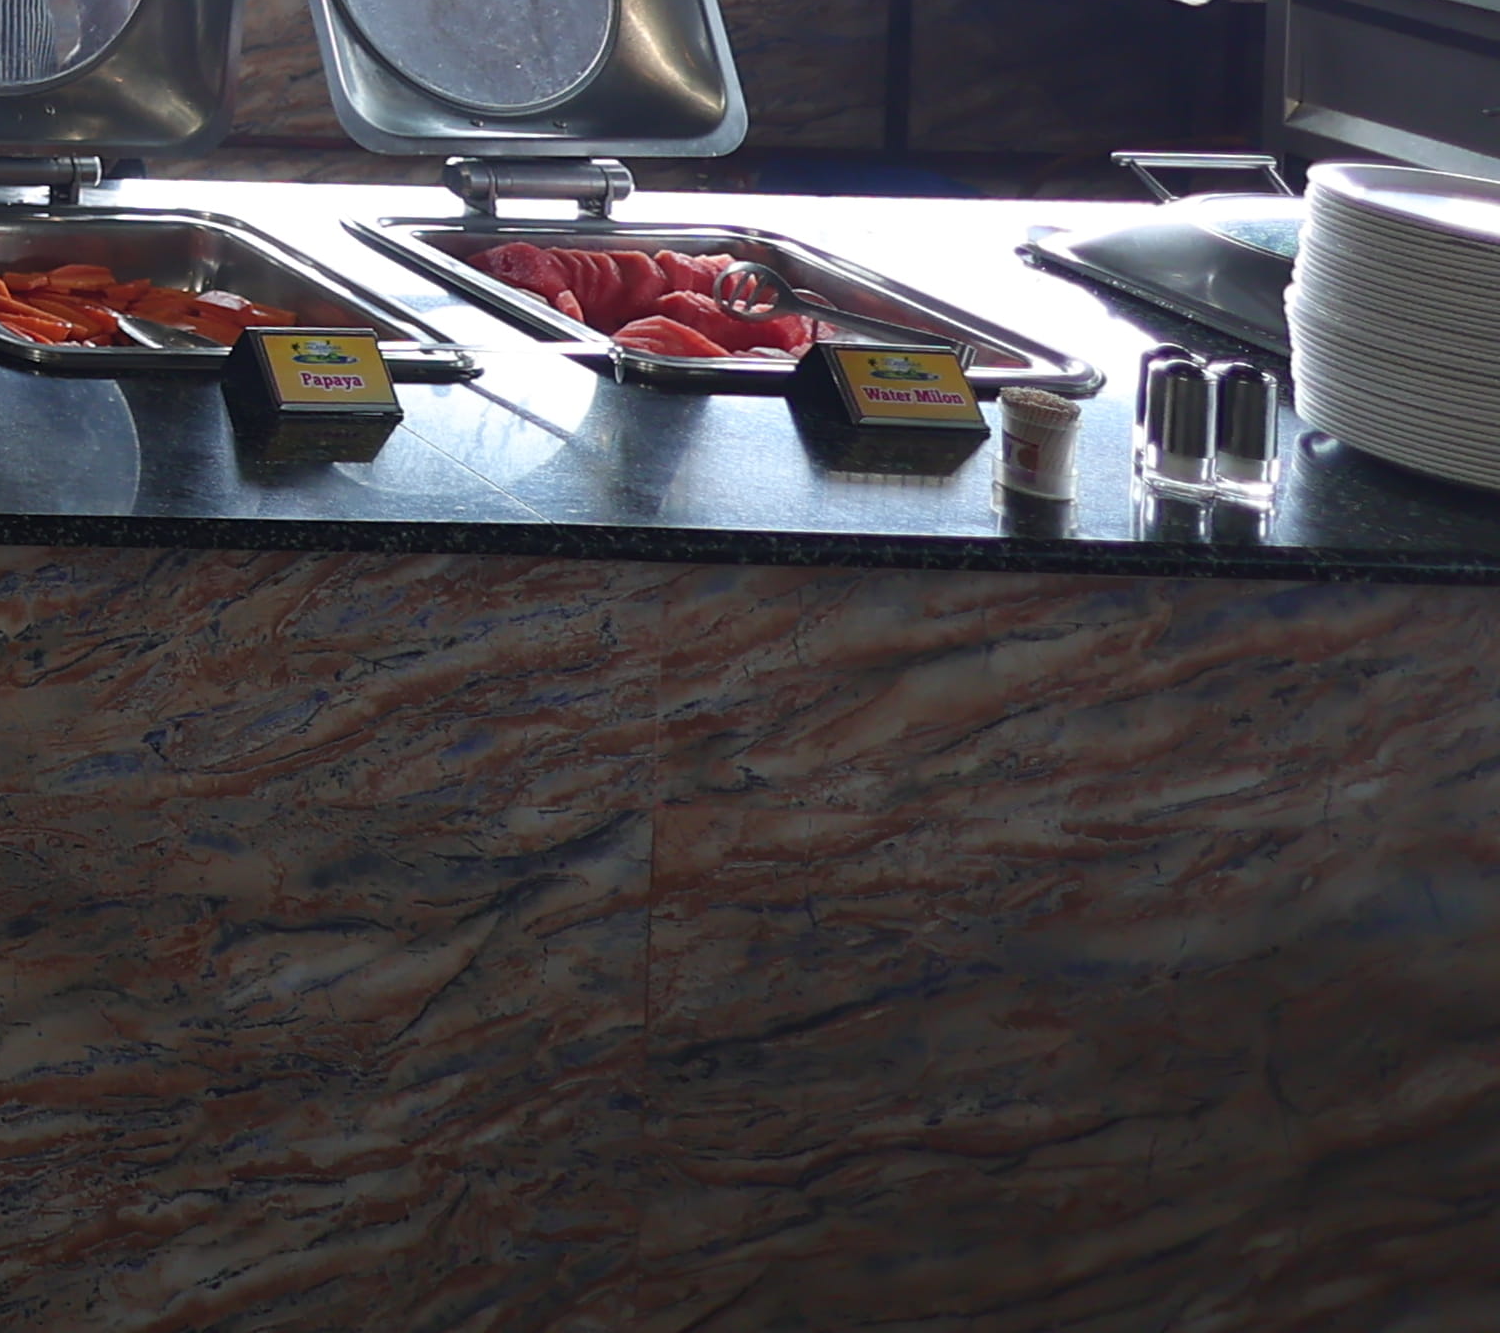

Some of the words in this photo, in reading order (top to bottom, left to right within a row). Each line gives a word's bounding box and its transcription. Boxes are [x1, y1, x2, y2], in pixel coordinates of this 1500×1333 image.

[301, 372, 364, 390] Papaya
[863, 387, 911, 402] Water
[913, 388, 965, 405] Milon
